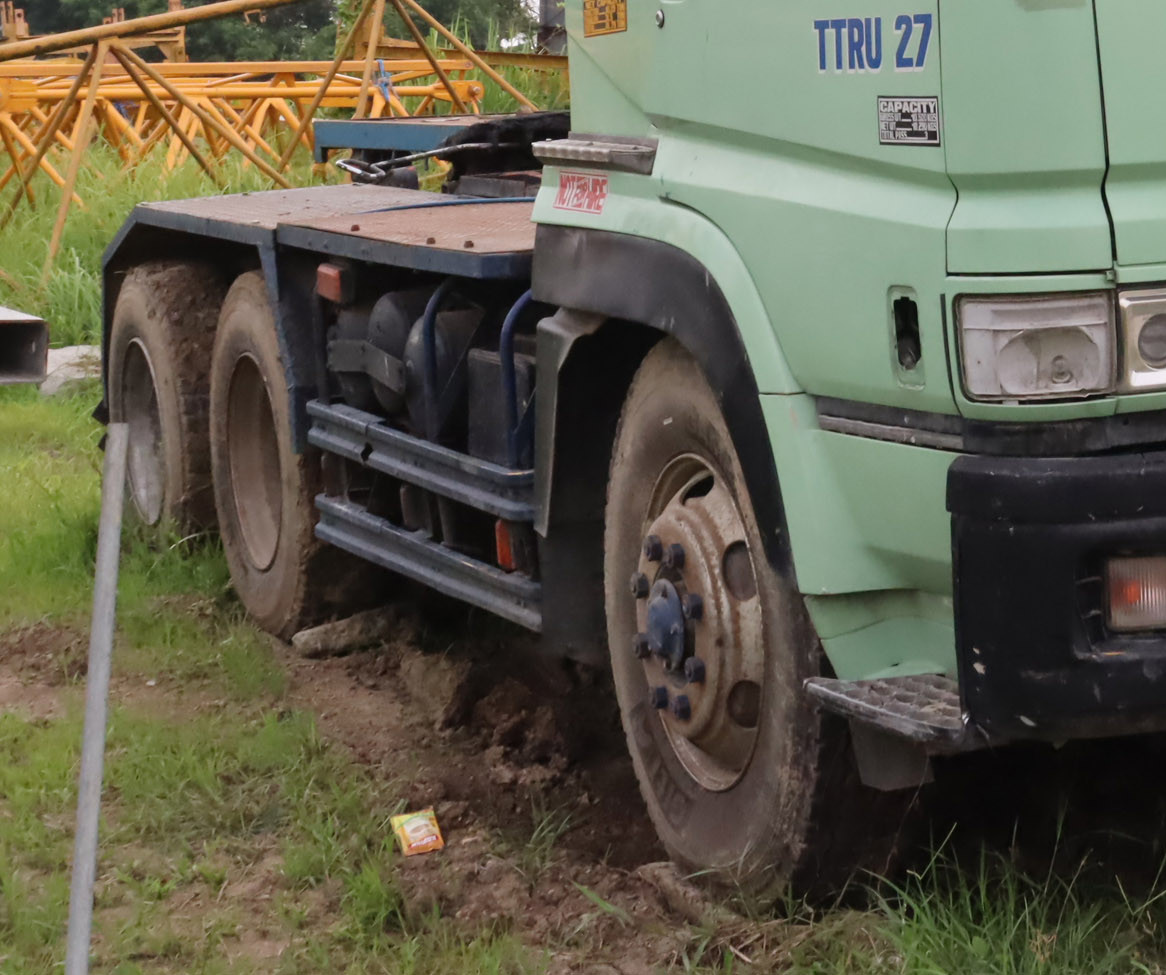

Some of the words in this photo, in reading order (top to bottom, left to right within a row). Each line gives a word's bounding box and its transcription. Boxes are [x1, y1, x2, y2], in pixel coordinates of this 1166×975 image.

[813, 16, 883, 74] TTRU
[893, 12, 933, 73] 27
[880, 101, 937, 113] CAPACITY
